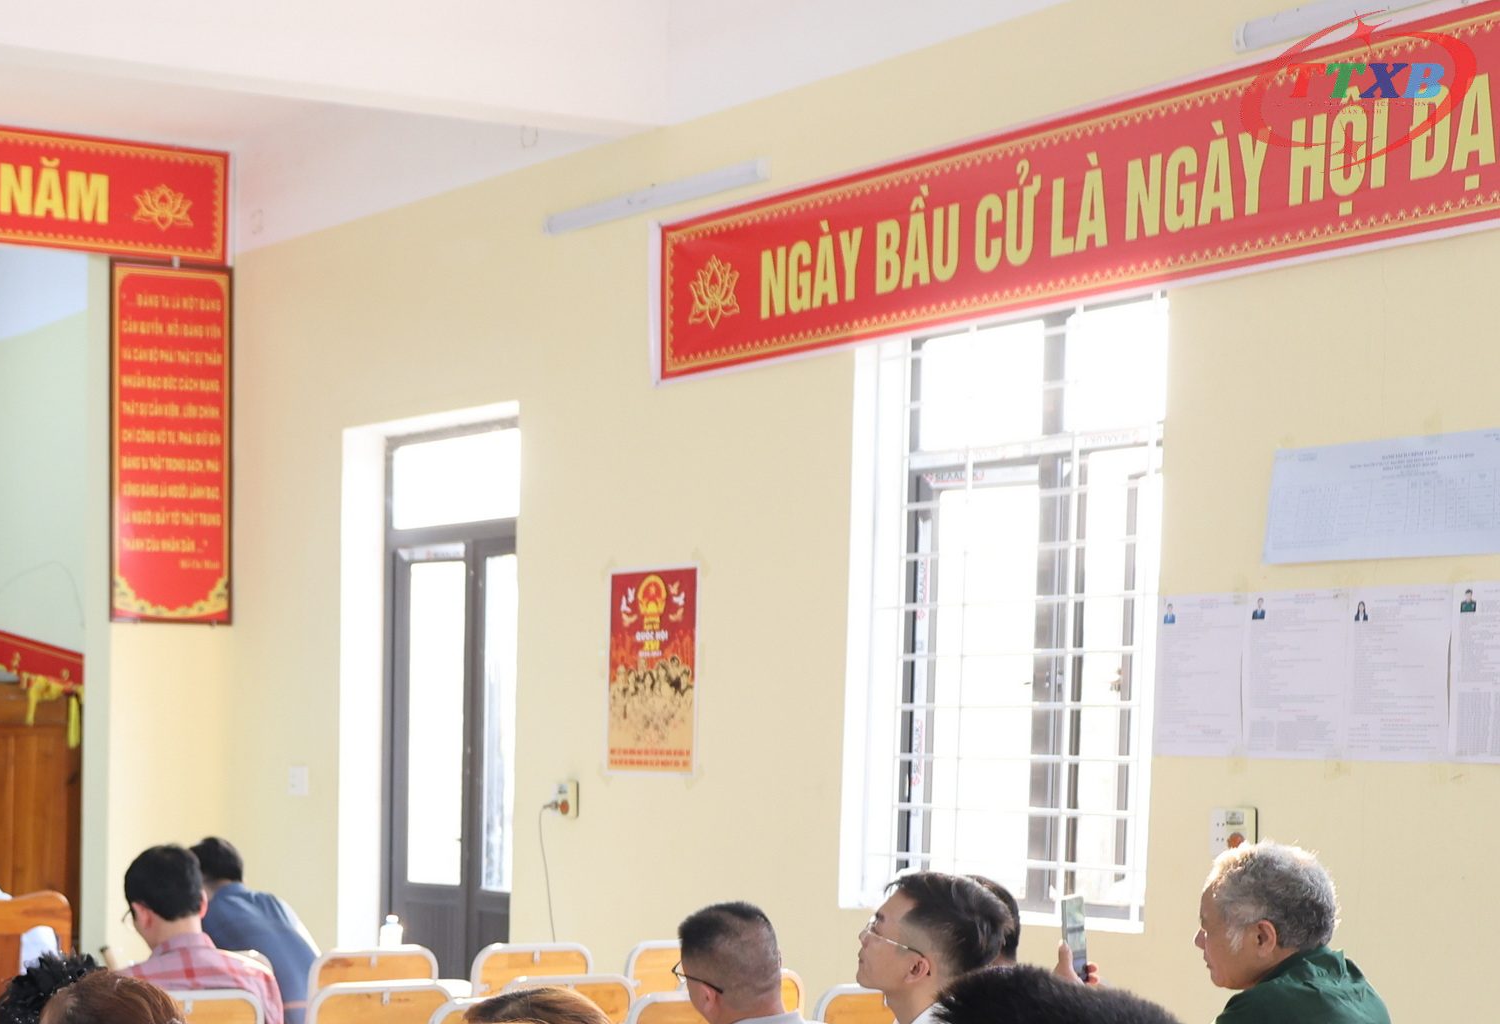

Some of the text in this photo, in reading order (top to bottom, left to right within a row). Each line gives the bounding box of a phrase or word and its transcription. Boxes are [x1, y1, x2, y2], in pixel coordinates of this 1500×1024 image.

[760, 220, 864, 319] NGÀY
[875, 185, 960, 294] BẦU
[975, 161, 1042, 273] CỬ
[1051, 150, 1108, 256] LÀ
[1126, 121, 1271, 240] NGÀY
[1288, 85, 1389, 217] HỘI
